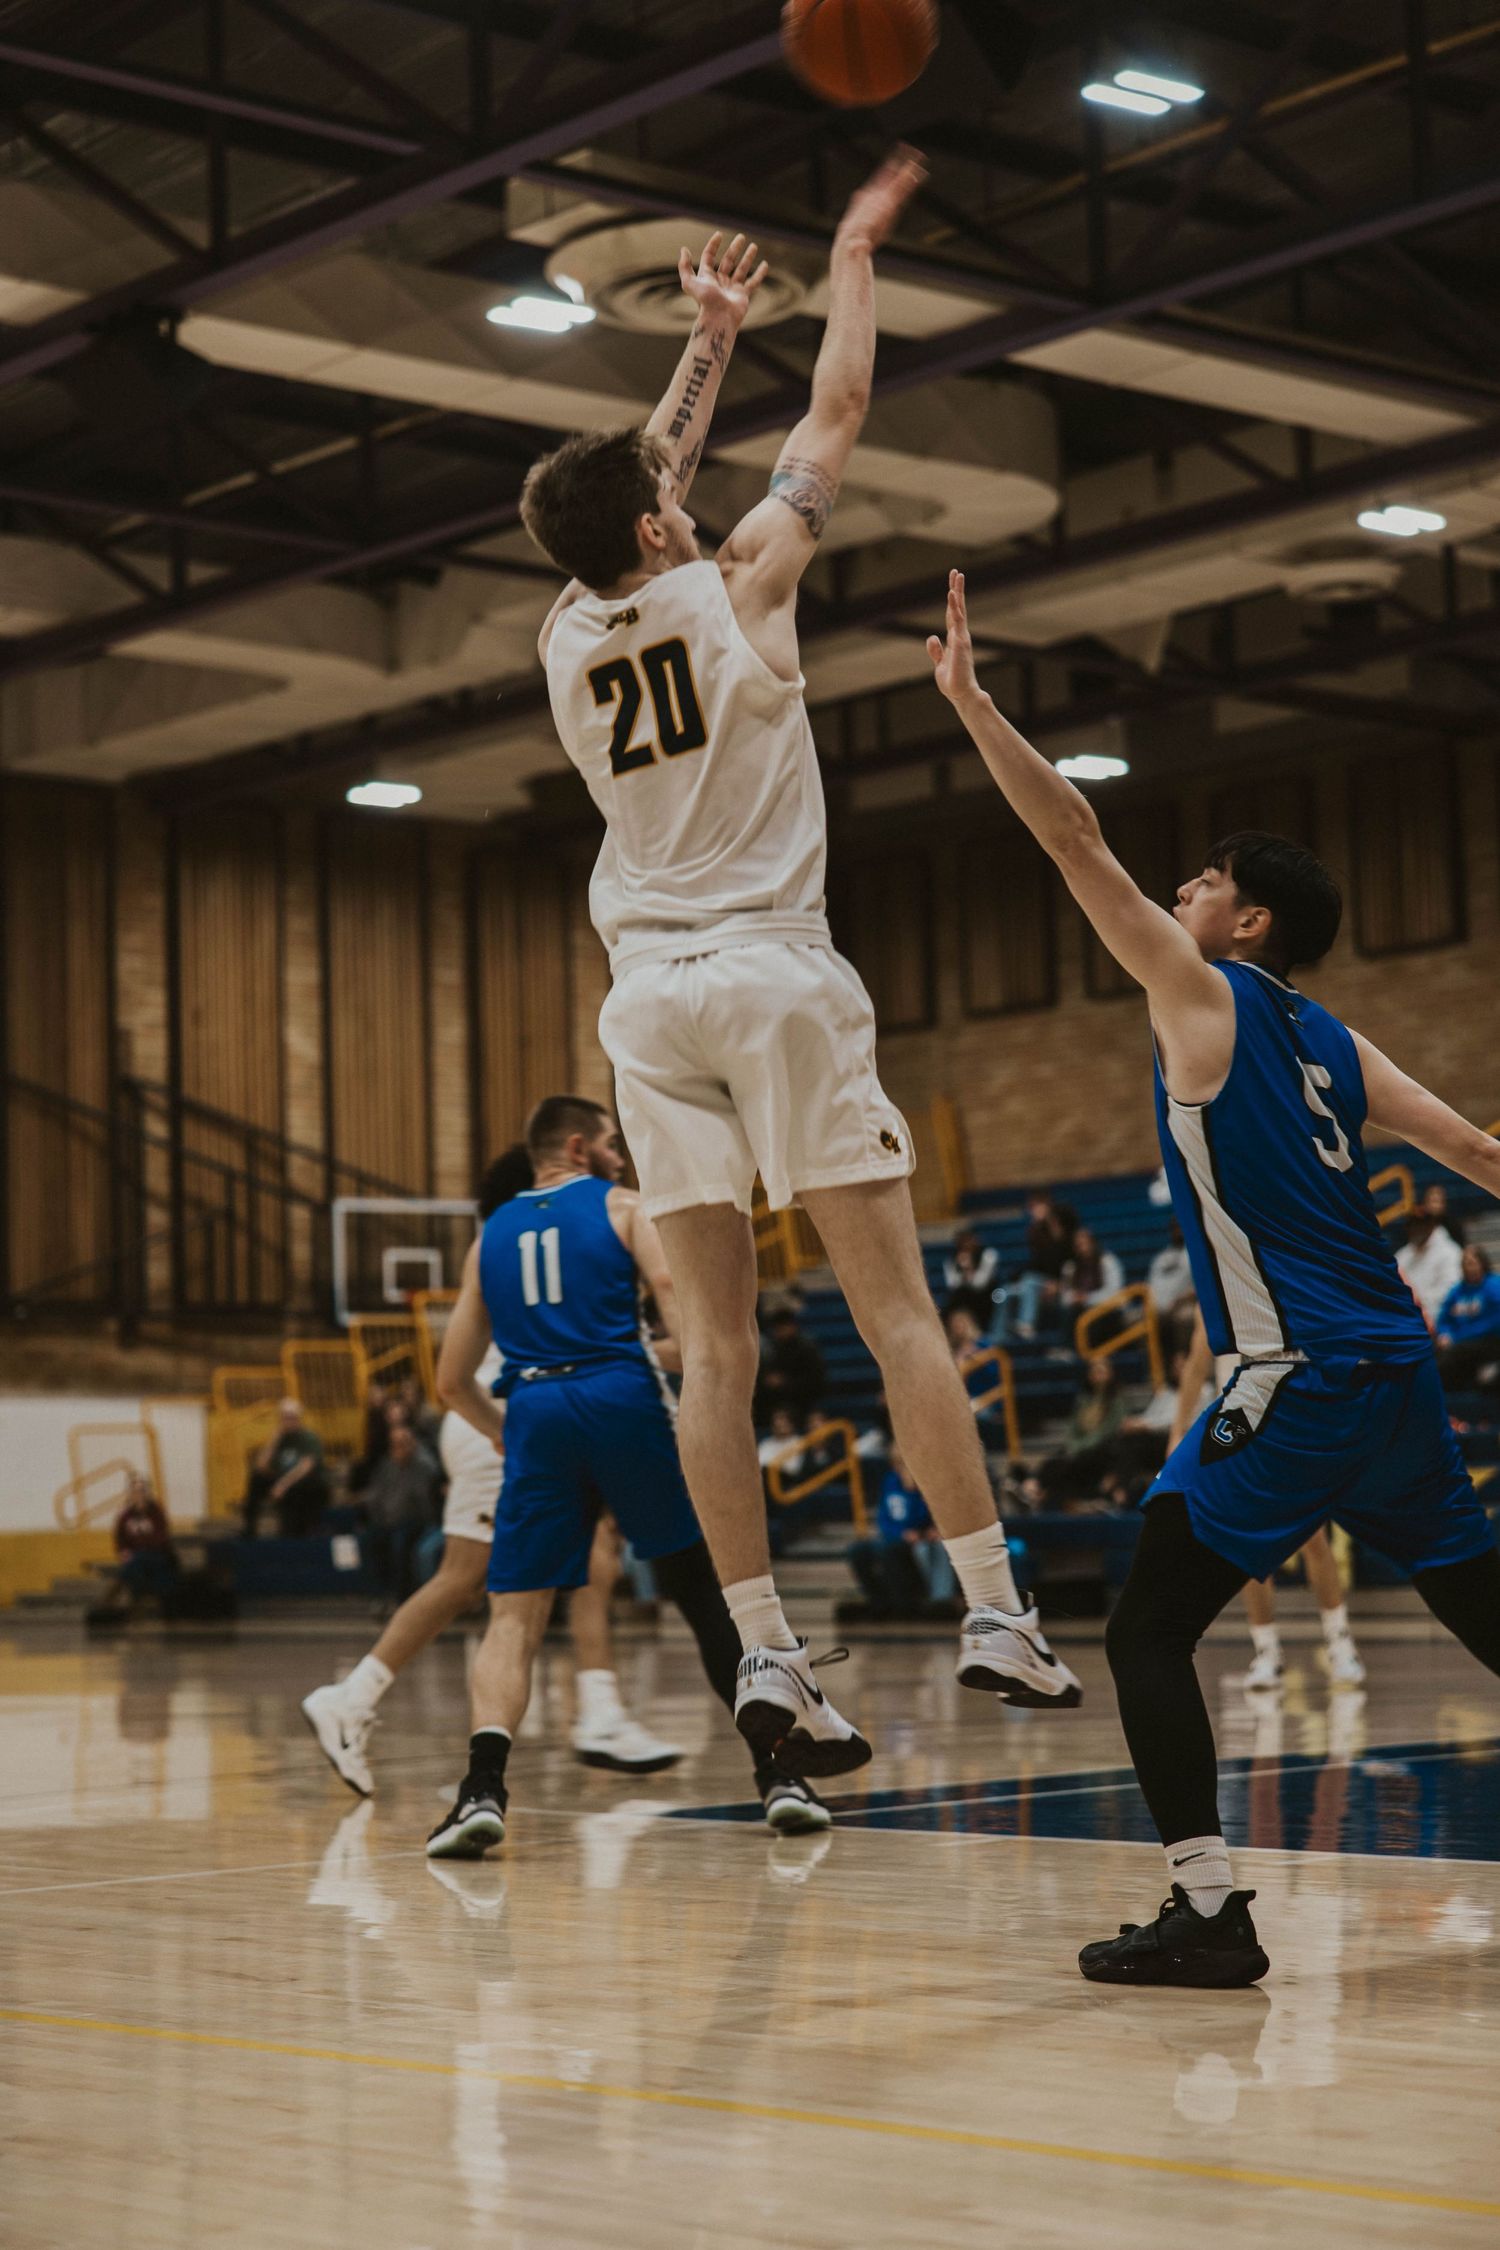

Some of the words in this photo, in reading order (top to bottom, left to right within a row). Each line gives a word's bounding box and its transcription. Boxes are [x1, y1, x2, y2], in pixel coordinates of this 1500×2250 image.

[667, 354, 713, 442] mperial
[585, 635, 709, 780] 20
[1296, 1055, 1354, 1173] 5
[518, 1227, 563, 1306] 11
